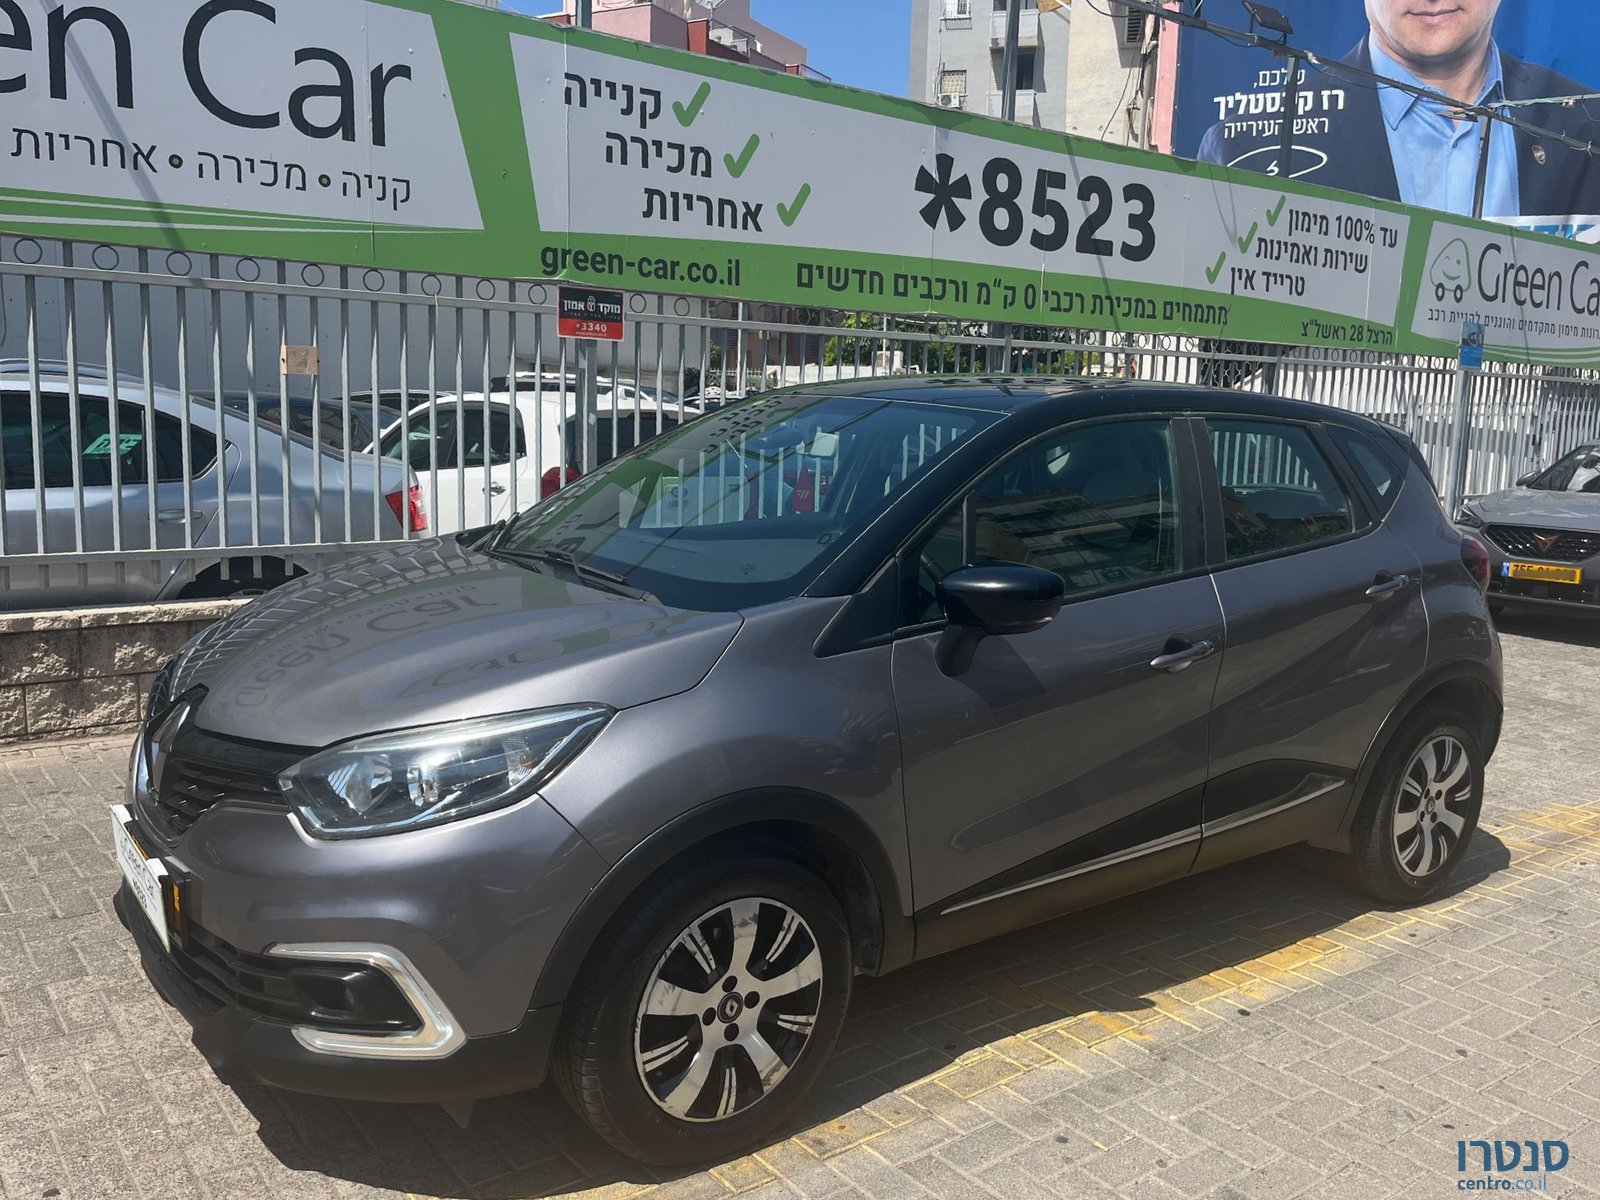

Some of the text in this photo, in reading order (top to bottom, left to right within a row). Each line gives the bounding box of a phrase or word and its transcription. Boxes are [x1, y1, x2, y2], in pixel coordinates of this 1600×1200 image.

[183, 0, 412, 147] Car
[565, 73, 661, 129] קנייה
[1321, 90, 1344, 110] רז
[1293, 118, 1328, 134] ראש
[606, 128, 711, 178] מכירה
[11, 128, 410, 211] קניה מכירה אחריות
[643, 188, 763, 232] אחריות
[1289, 209, 1397, 248] עד 100% מימון
[541, 246, 740, 287] green-car.co.il
[1256, 234, 1367, 273] שירות ואמינות
[797, 263, 883, 295] חדשים
[894, 274, 967, 303] ורכבים
[1231, 267, 1305, 296] טרייד אין
[1478, 243, 1562, 309] Green
[1024, 284, 1036, 309] 0
[1043, 290, 1084, 313] רכבי
[1091, 295, 1156, 319] במכירת
[1163, 301, 1227, 325] מתמחים
[1428, 309, 1445, 321] רכב
[1350, 325, 1363, 342] 28
[1367, 325, 1392, 345] הרצל
